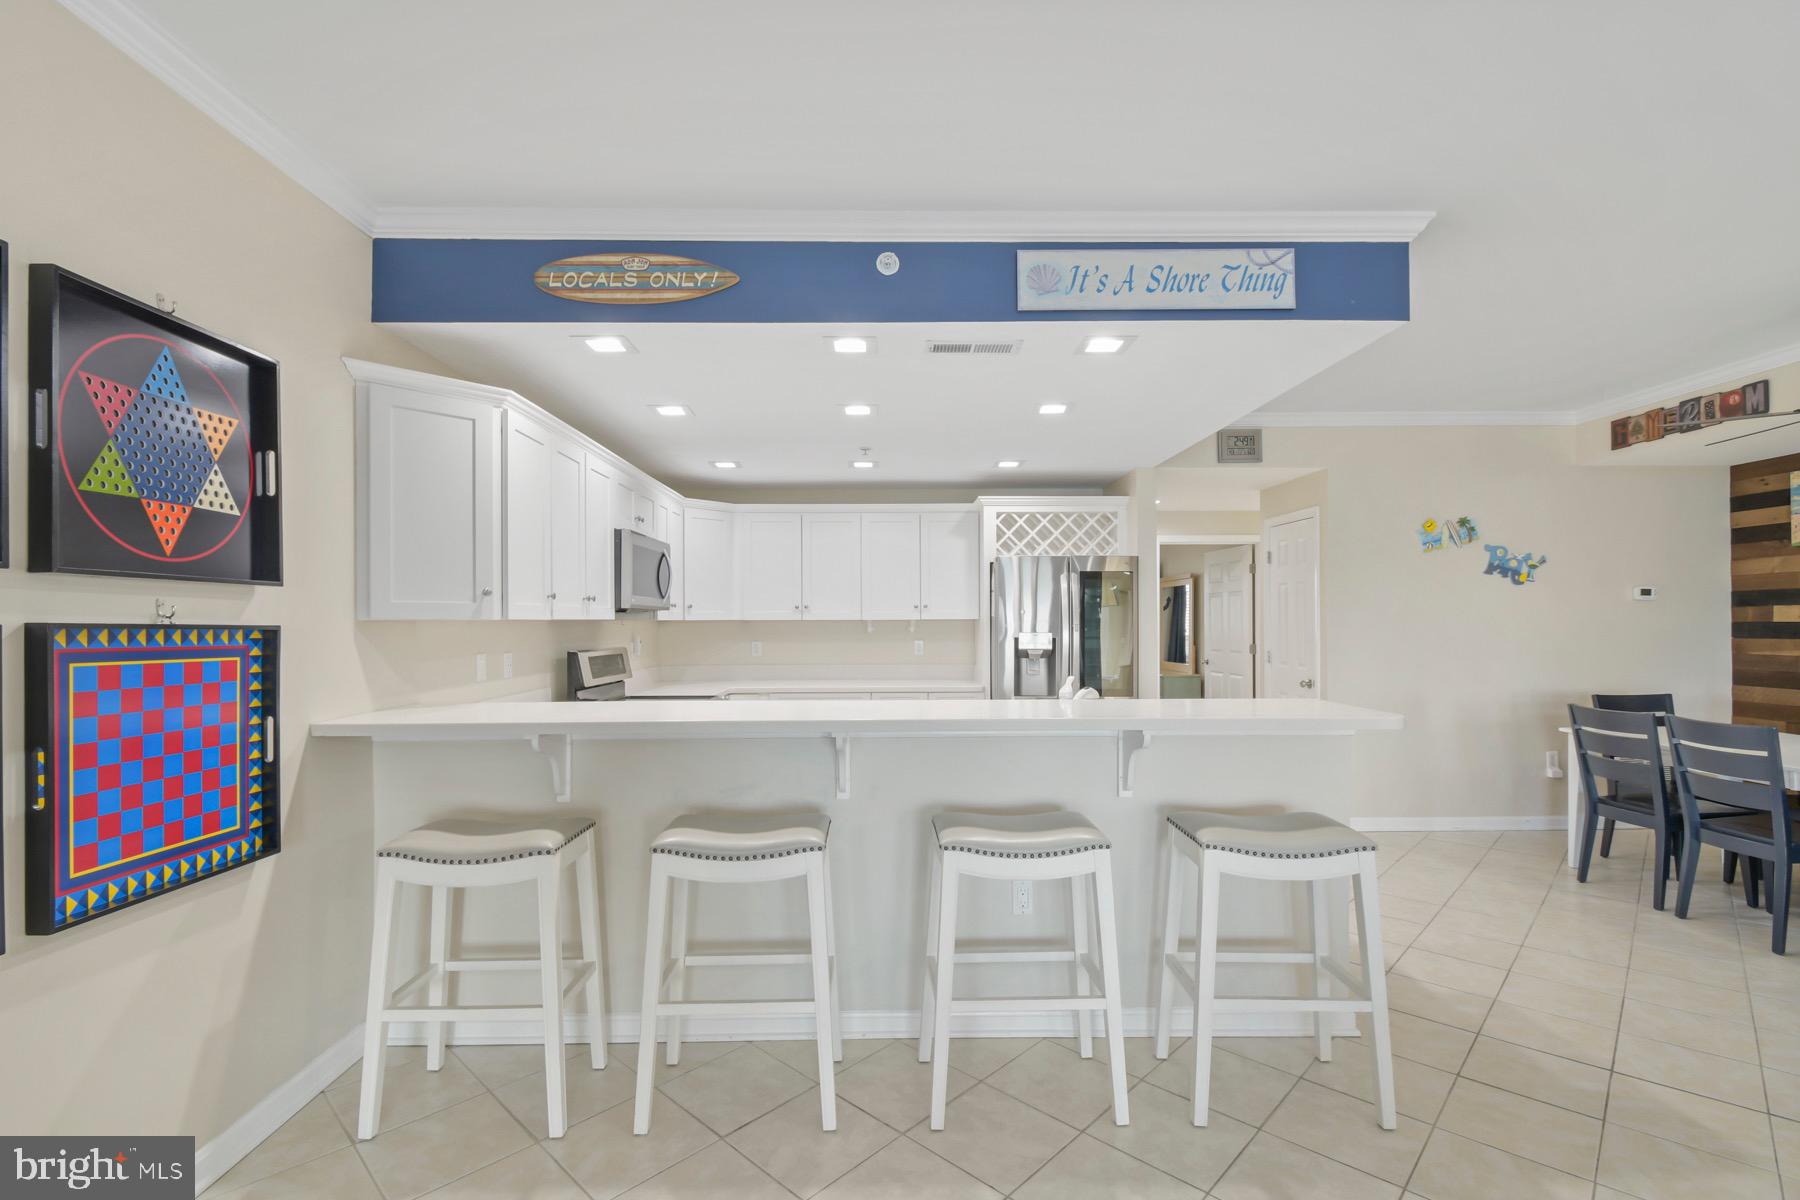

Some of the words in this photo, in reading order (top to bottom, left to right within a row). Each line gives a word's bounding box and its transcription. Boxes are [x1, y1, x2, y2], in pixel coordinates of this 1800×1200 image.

[549, 271, 638, 288] LOCALS
[649, 271, 719, 288] ONLY!
[1065, 264, 1109, 294] It's
[1113, 264, 1135, 296] A
[1146, 264, 1211, 294] Shore
[1221, 264, 1288, 300] Thing
